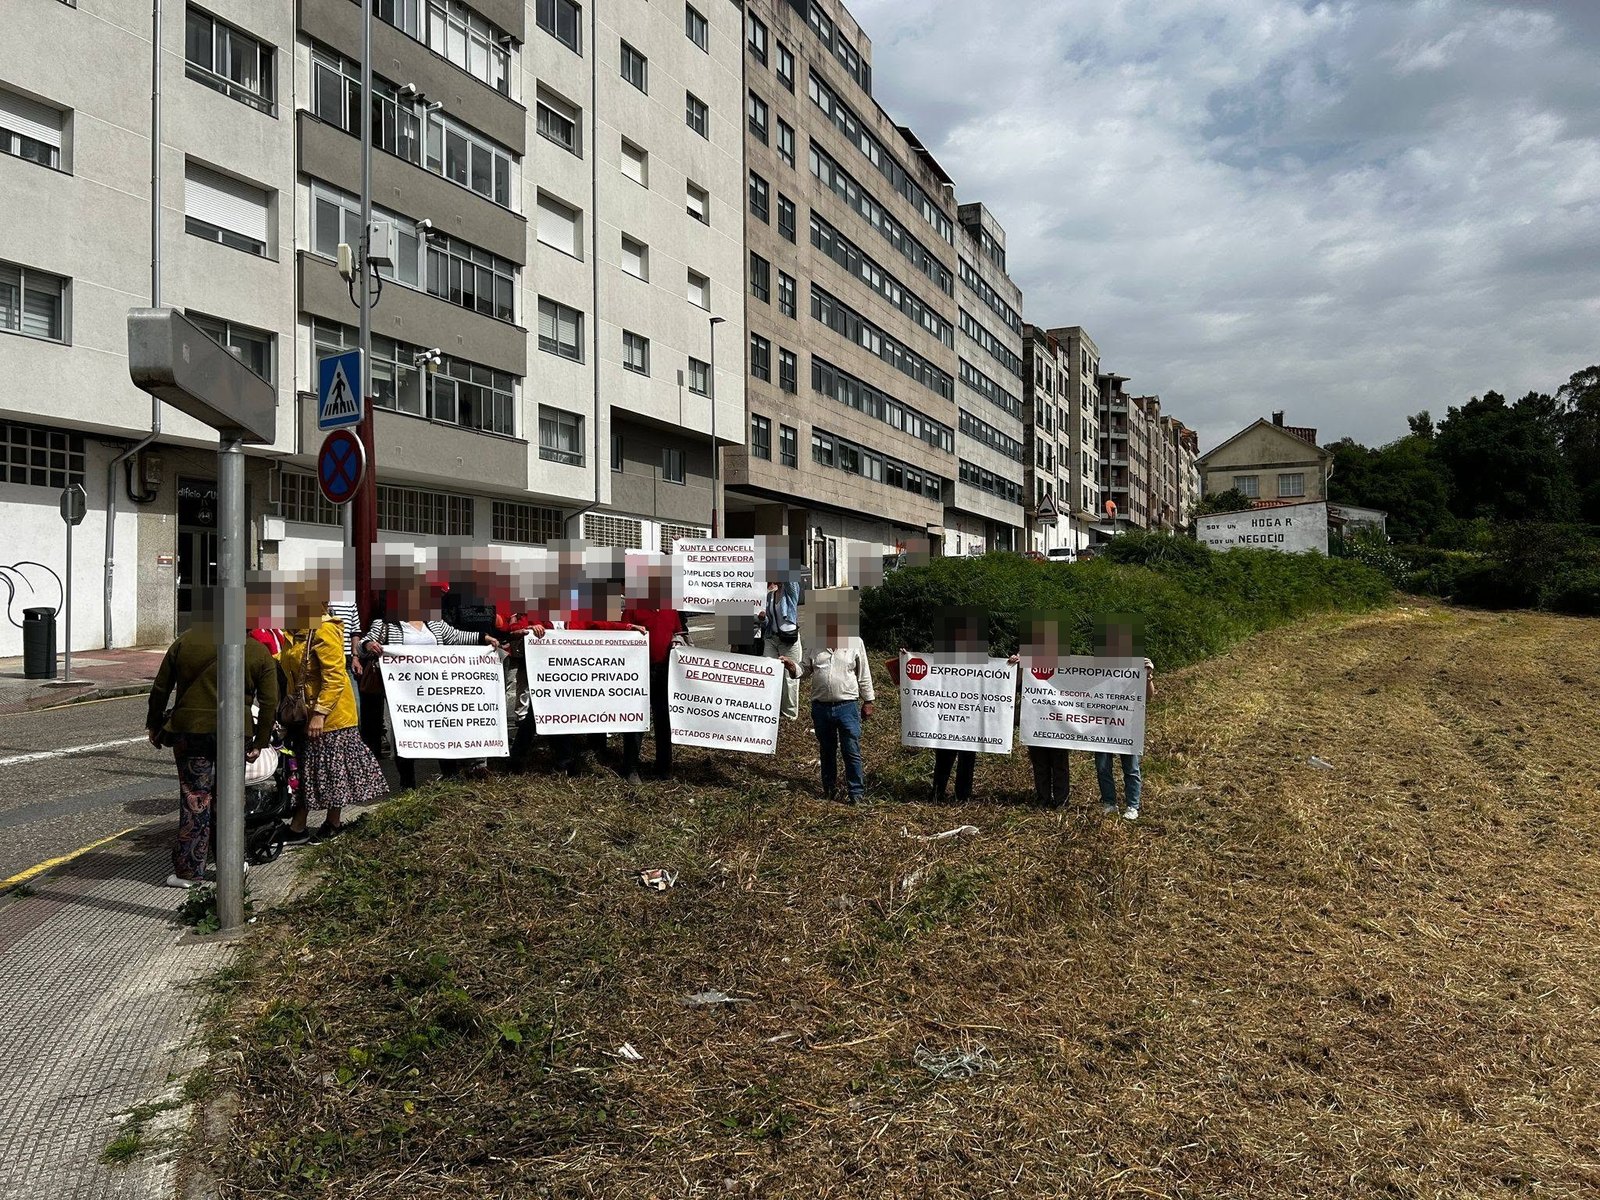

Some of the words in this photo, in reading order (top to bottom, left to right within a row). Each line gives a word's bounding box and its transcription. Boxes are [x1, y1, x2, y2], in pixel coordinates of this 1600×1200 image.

[178, 487, 200, 498] dificio
[204, 491, 217, 499] SU
[1252, 518, 1292, 527] HOGAR
[680, 544, 706, 552] XUNTA
[382, 654, 466, 664] EXPROPIACIÓN
[548, 658, 625, 666] ENMASCARAN
[678, 655, 710, 667] XUNTA
[722, 660, 773, 674] CONCELLO
[388, 673, 395, 681] A
[398, 672, 411, 681] 2€
[414, 672, 438, 681] NON
[442, 670, 448, 680] É
[537, 673, 588, 682] NEGOCIO
[591, 673, 639, 681] PRIVADO
[906, 665, 927, 674] STOP
[930, 666, 1010, 679] EXPROPIACIÓN
[1058, 667, 1140, 679] EXPROPIACIÓN
[686, 670, 699, 679] DE
[702, 672, 765, 688] PONTEVEDRA
[416, 685, 424, 696] É
[428, 687, 485, 696] DESPREZO.
[531, 689, 551, 697] POR
[554, 688, 606, 697] VIVIENDA
[608, 688, 648, 696] SOCIAL
[912, 689, 958, 699] TRABALLO
[960, 692, 979, 700] DOS
[981, 694, 1012, 702] NOSOS
[1024, 687, 1056, 695] XUNTA:
[1060, 690, 1092, 698] ESCOITA,
[396, 702, 458, 713] XERACIÓNS
[461, 703, 475, 712] DE
[478, 703, 499, 711] LOITA
[673, 692, 713, 704] ROUBAN
[725, 698, 772, 711] TRABALLO
[911, 700, 935, 708] AVÓS
[937, 702, 956, 710] NON
[958, 703, 981, 712] ESTÁ
[1032, 698, 1056, 706] CASAS
[1087, 703, 1134, 711] EXPROPIAN...
[620, 713, 644, 722] NON
[687, 707, 720, 718] NOSOS
[722, 712, 777, 724] ANCENTROS
[1066, 714, 1125, 726] RESPETAN
[404, 719, 424, 728] NON
[427, 717, 463, 728] TEÑEN
[466, 718, 498, 726] PREZO.
[671, 729, 710, 739] FECTADOS
[726, 735, 742, 743] SAN
[744, 737, 772, 746] AMARO
[907, 731, 947, 740] AFECTADOS
[978, 736, 1003, 745] MAURO
[1033, 731, 1075, 740] AFECTADOS
[1107, 736, 1133, 745] MAURO
[398, 741, 445, 749] AFECTADOS
